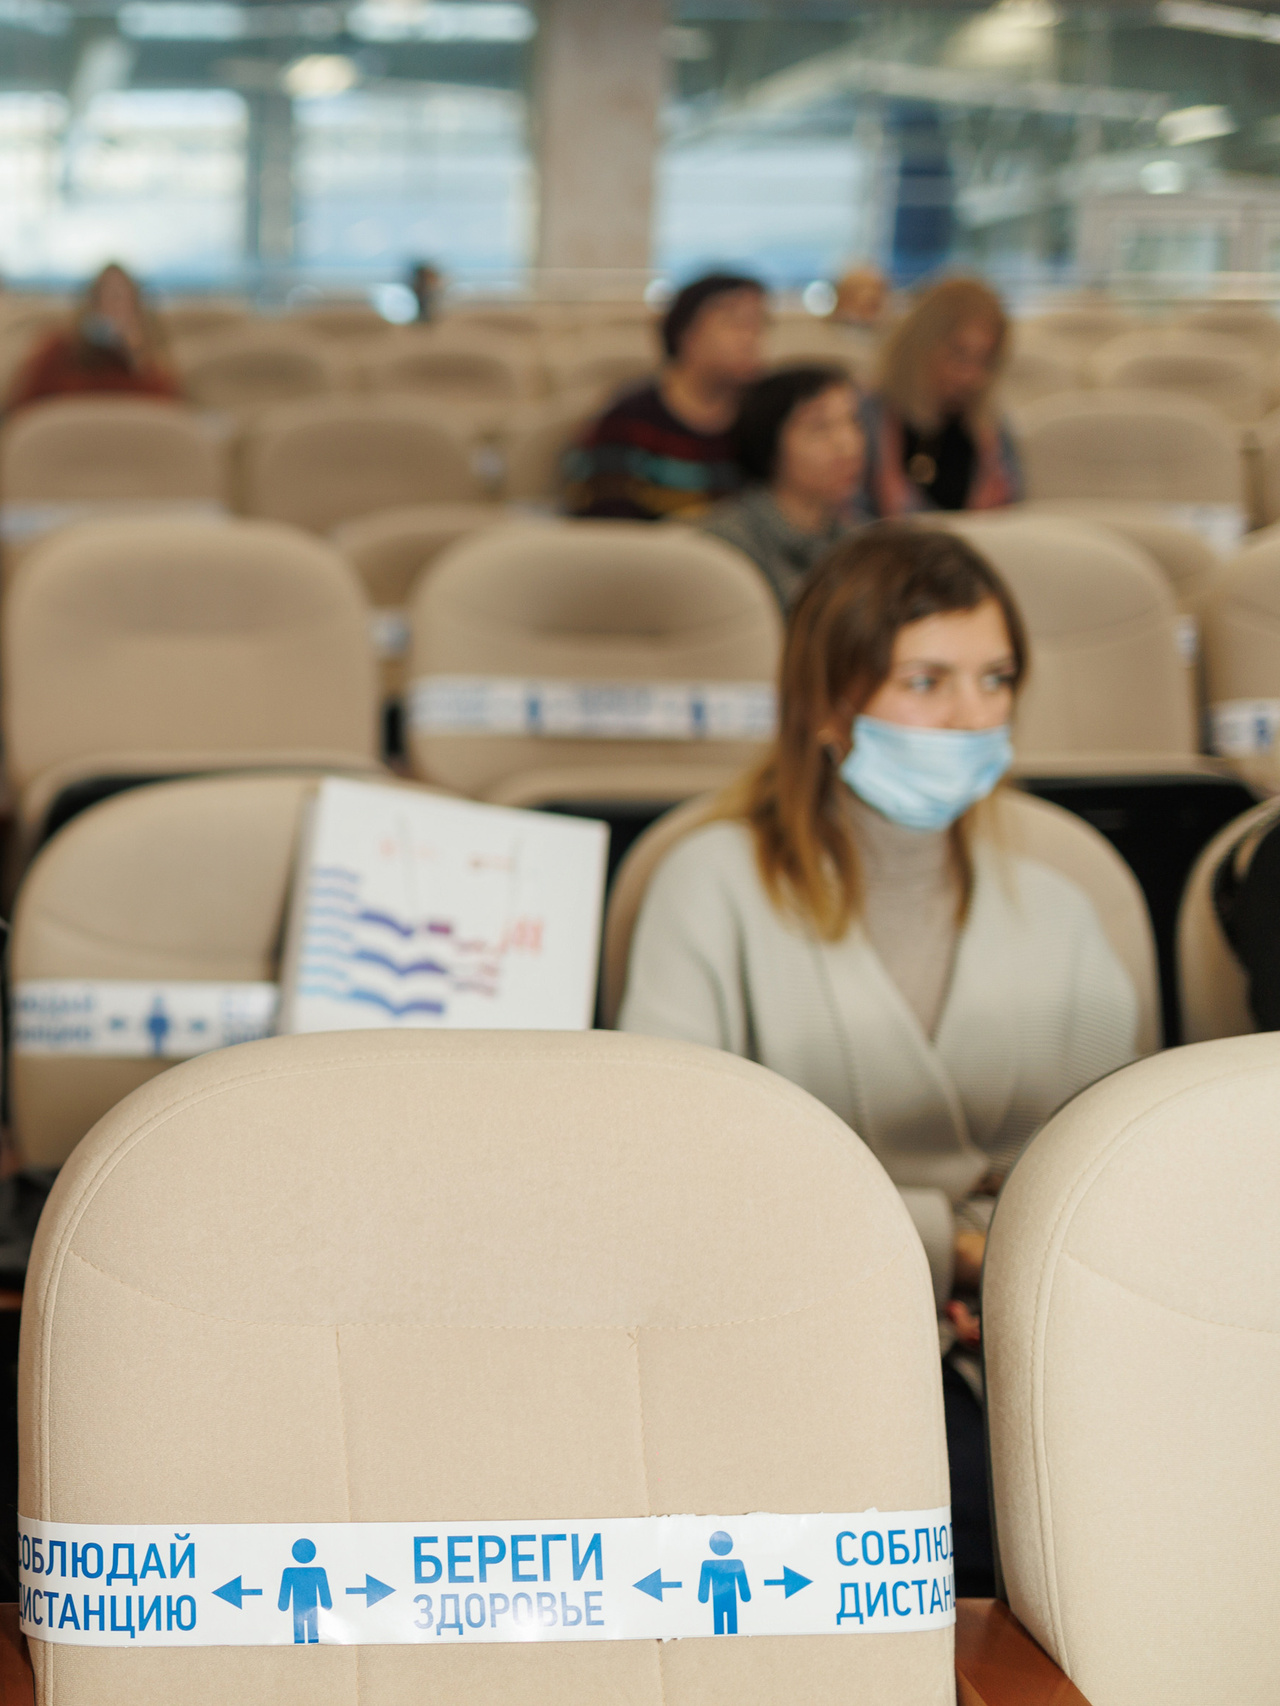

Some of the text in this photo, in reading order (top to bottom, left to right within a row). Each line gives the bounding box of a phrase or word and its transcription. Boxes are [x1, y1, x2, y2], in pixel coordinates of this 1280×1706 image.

[17, 1532, 196, 1587] ОБЛЮДАЙ
[413, 1533, 604, 1584] БЕРЕГИ
[412, 1590, 605, 1636] ЗДОРОВЬЕ
[836, 1573, 957, 1626] ДИСТАН
